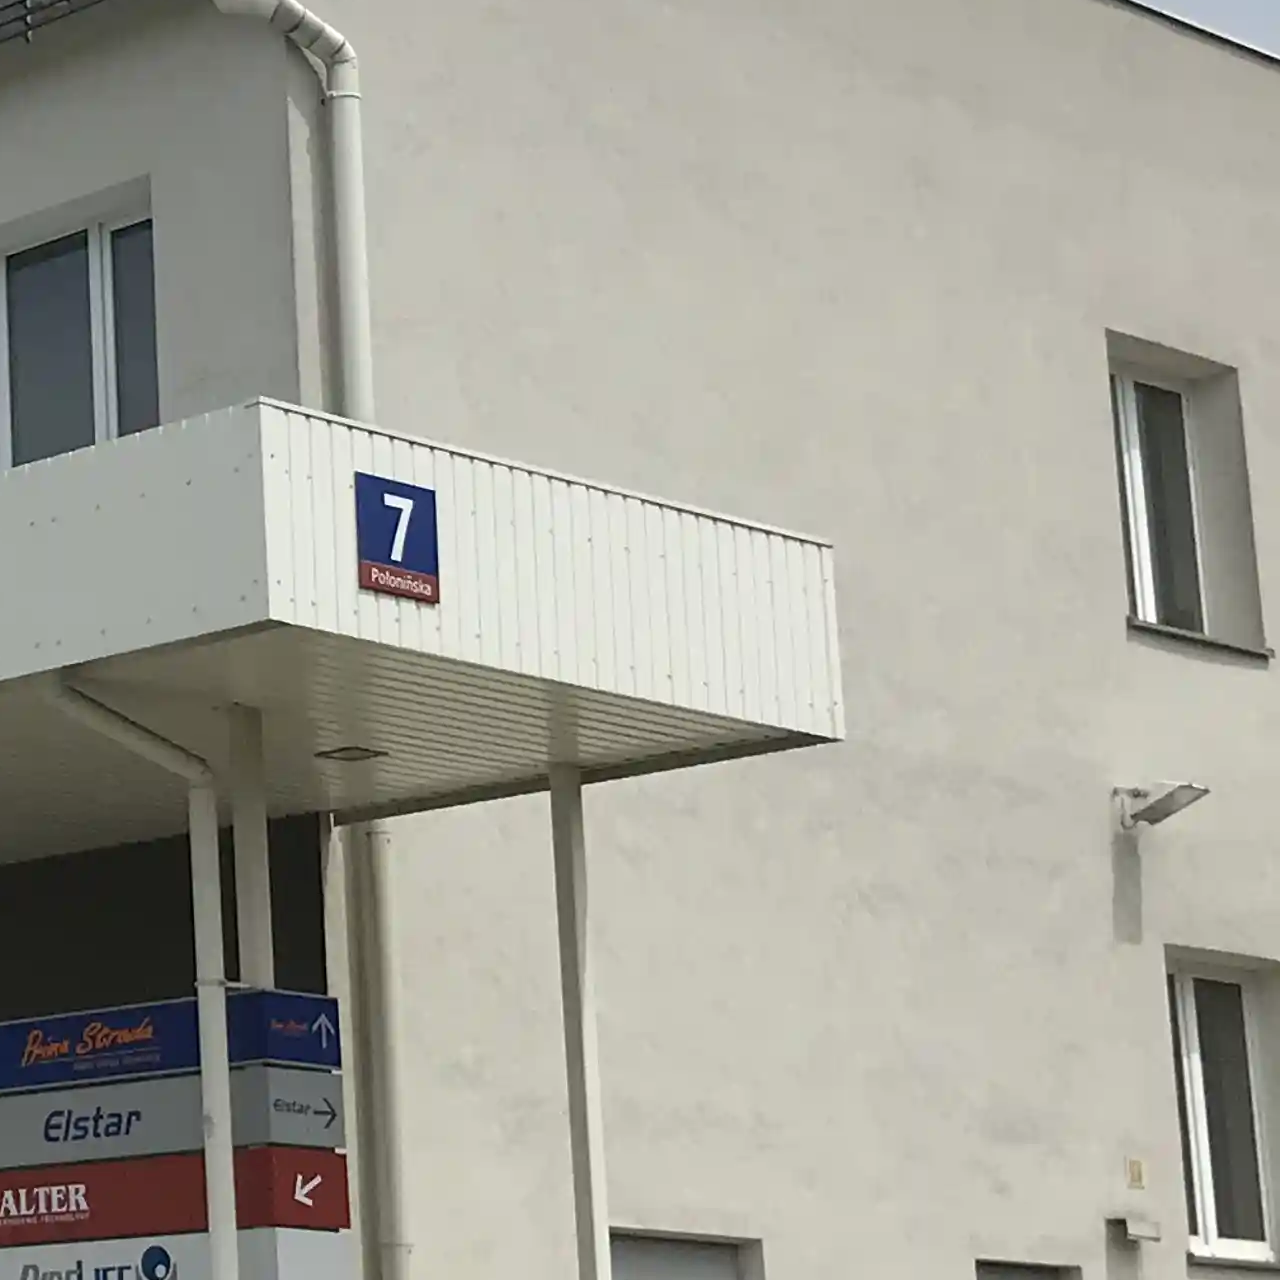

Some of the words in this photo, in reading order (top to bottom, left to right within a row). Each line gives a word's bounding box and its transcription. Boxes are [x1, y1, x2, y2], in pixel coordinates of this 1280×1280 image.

[383, 493, 414, 562] 7
[44, 1106, 142, 1142] Elstar
[273, 1098, 311, 1116] Elstar
